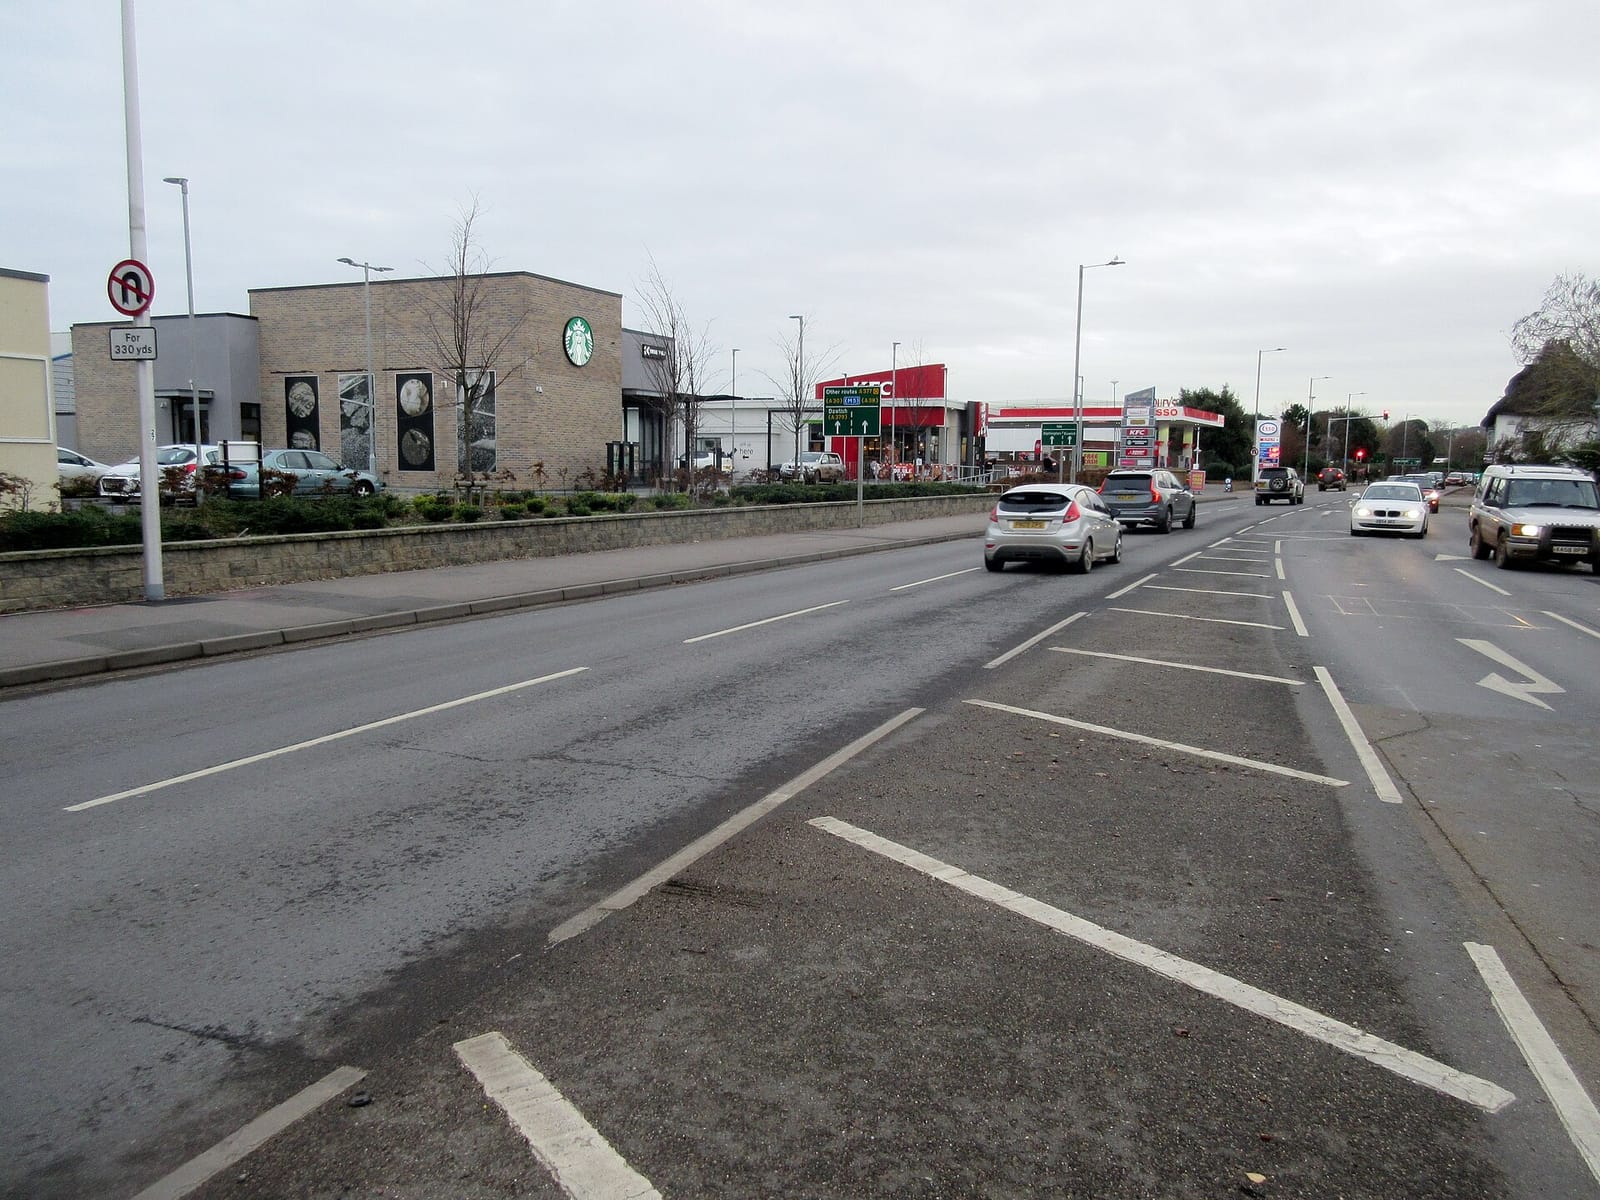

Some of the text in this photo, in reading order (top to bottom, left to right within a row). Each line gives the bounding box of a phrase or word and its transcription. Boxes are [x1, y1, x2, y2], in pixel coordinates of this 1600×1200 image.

[125, 333, 140, 342] For
[115, 345, 153, 356] 330 yds
[1155, 408, 1178, 416] SSO
